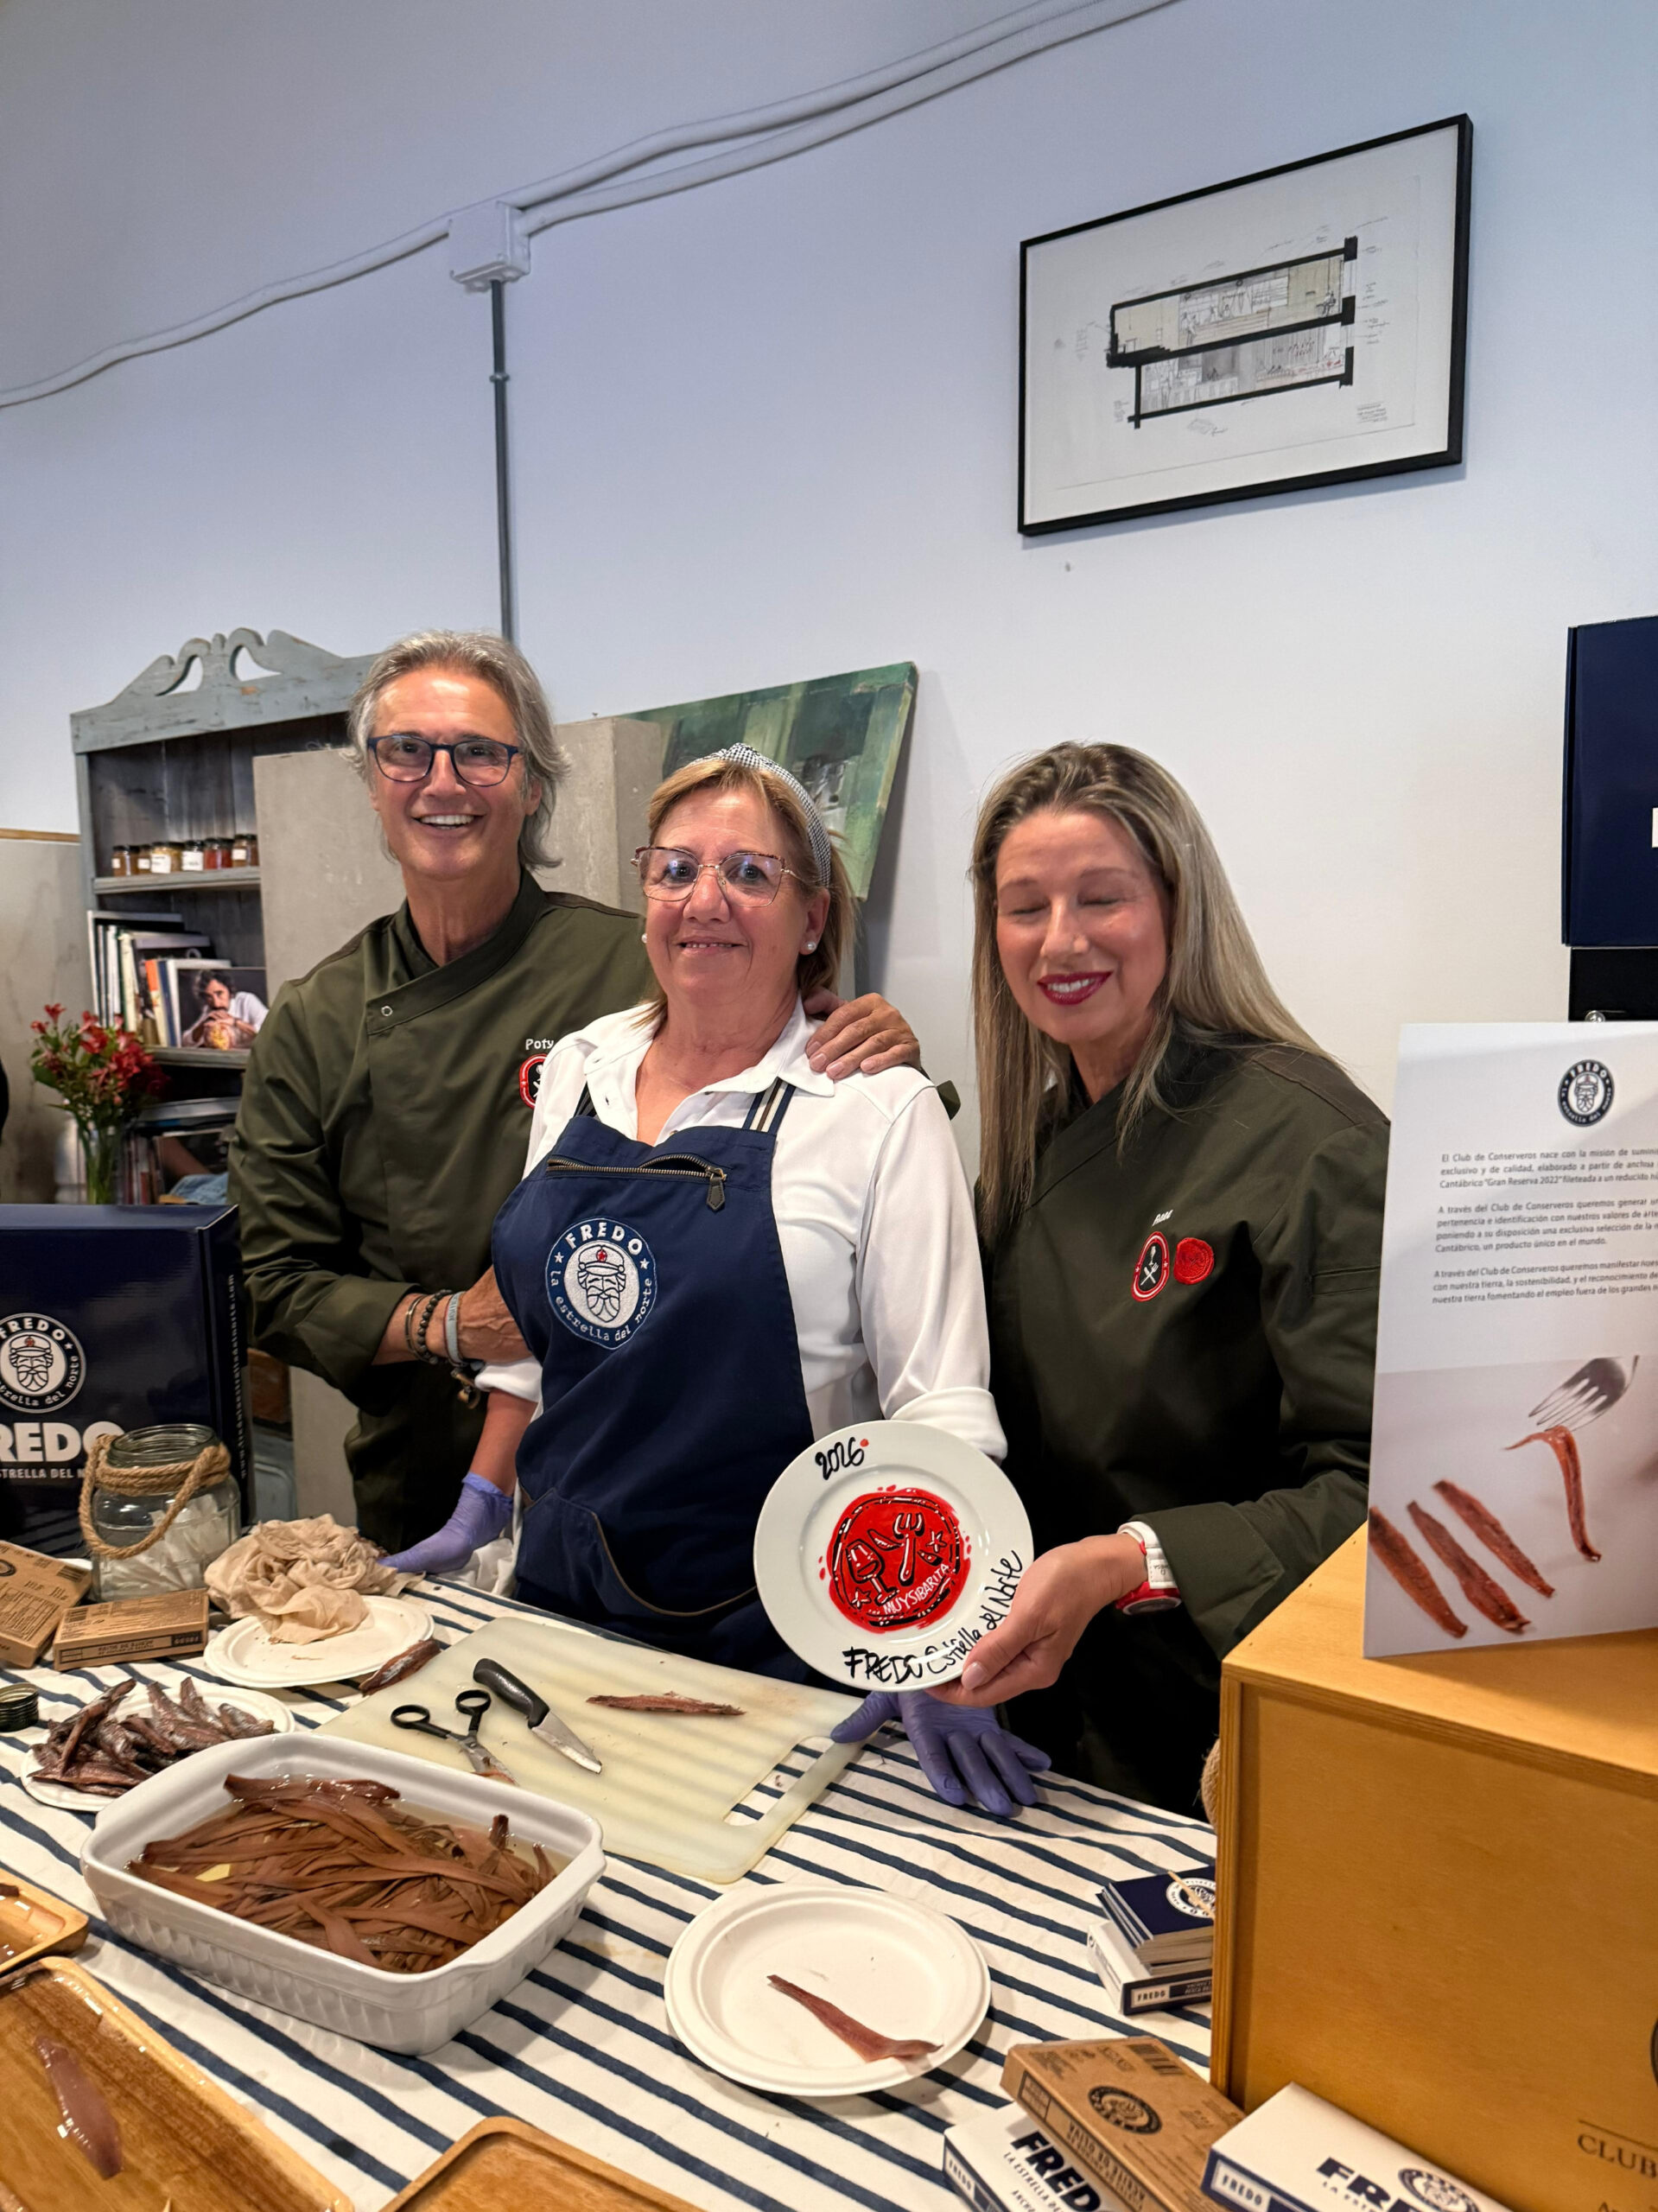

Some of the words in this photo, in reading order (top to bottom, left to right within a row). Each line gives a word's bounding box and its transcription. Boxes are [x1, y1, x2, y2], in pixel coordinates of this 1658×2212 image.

[525, 1038, 554, 1051] Poty
[1452, 1154, 1471, 1162] Club
[1538, 1163, 1577, 1172] elaborado
[1588, 1162, 1610, 1171] partir
[1439, 1179, 1483, 1188] Cantábrico
[1508, 1177, 1538, 1185] Reserva
[1438, 1205, 1445, 1214] A
[1475, 1204, 1488, 1213] del
[1490, 1203, 1509, 1211] Club
[1526, 1201, 1574, 1211] Conserveros
[1576, 1200, 1615, 1209] queremos
[1617, 1198, 1647, 1209] generar
[1437, 1217, 1485, 1228] pertenencia
[1602, 1211, 1629, 1219] valores
[564, 1222, 643, 1255] FREDO
[1436, 1230, 1476, 1242] poniendo
[1559, 1225, 1594, 1234] exclusiva
[1495, 1242, 1532, 1251] producto
[1466, 1268, 1479, 1277] del
[1480, 1267, 1499, 1275] Club
[1511, 1265, 1559, 1274] Conserveros
[1560, 1263, 1598, 1272] queremos
[1599, 1261, 1640, 1269] manifestar
[550, 1270, 562, 1287] la
[1450, 1281, 1479, 1290] nuestra
[1573, 1276, 1579, 1285] y
[1588, 1273, 1648, 1282] reconocimiento
[634, 1278, 652, 1324] norte
[1432, 1295, 1463, 1304] nuestra
[1464, 1294, 1486, 1302] tierra
[1487, 1291, 1535, 1300] fomentando
[1545, 1288, 1575, 1298] empleo
[1597, 1286, 1607, 1294] de
[1621, 1284, 1651, 1294] grandes
[555, 1296, 610, 1341] estrella
[614, 1325, 632, 1341] del
[45, 1390, 66, 1404] del
[0, 1469, 47, 1478] TRELLA
[50, 1468, 74, 1478] DEL
[842, 1646, 924, 1684] FREDO
[1137, 1990, 1166, 2001] FREDO
[1578, 2133, 1657, 2178] CLUB
[1223, 2174, 1262, 2206] FREDO
